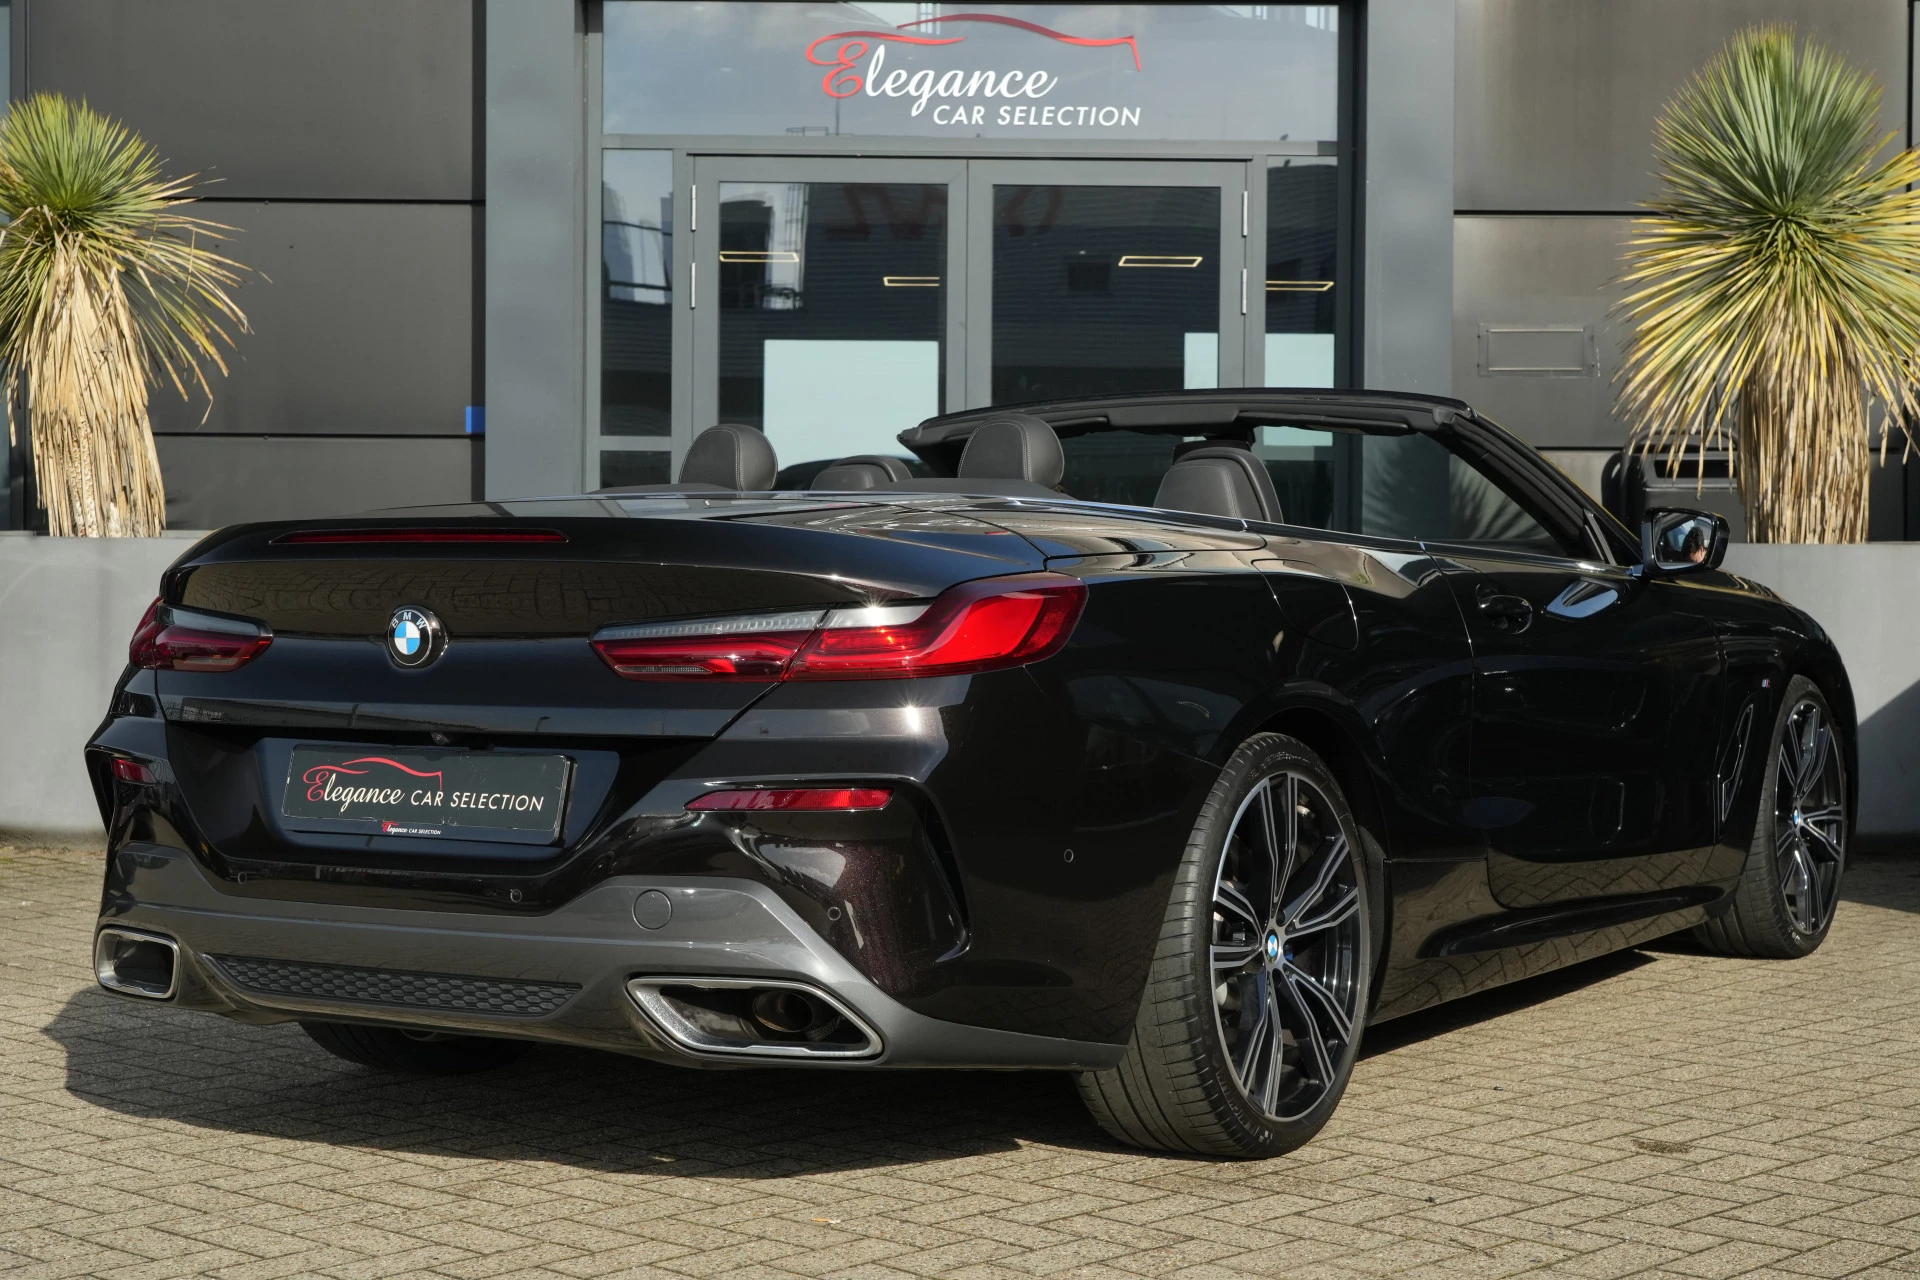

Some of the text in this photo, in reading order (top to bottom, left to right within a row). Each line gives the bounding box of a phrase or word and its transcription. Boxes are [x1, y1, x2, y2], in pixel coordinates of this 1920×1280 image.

[805, 32, 1058, 117] Elegance
[933, 105, 1141, 127] CAR SELECTION
[391, 612, 427, 629] BMW
[303, 767, 544, 813] Elegance CAR SELECTION
